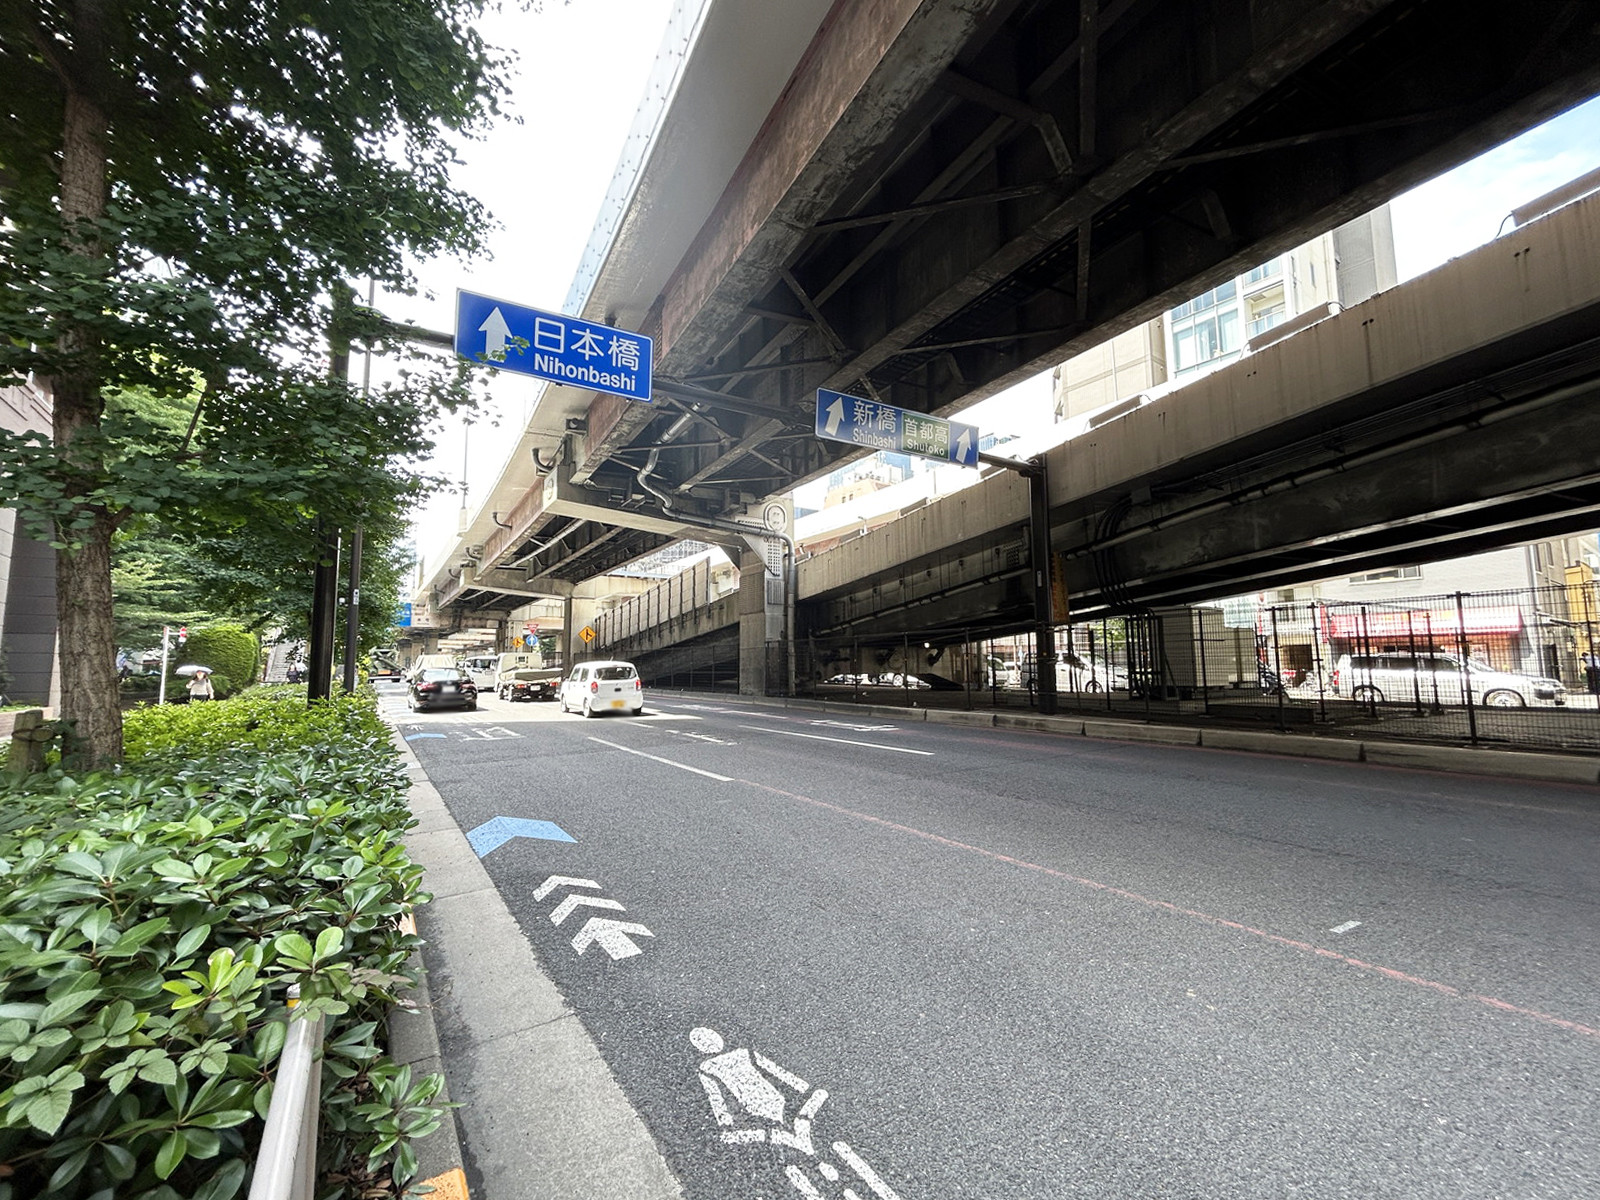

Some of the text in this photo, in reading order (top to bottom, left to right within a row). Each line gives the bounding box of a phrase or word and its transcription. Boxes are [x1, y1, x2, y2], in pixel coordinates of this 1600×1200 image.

[534, 316, 640, 372] 日本橋
[534, 353, 636, 392] Nihonbashi
[853, 400, 896, 433] 新橋
[904, 418, 948, 444] 首都高
[852, 427, 896, 450] Shinbashi
[906, 439, 945, 456] Shutoko
